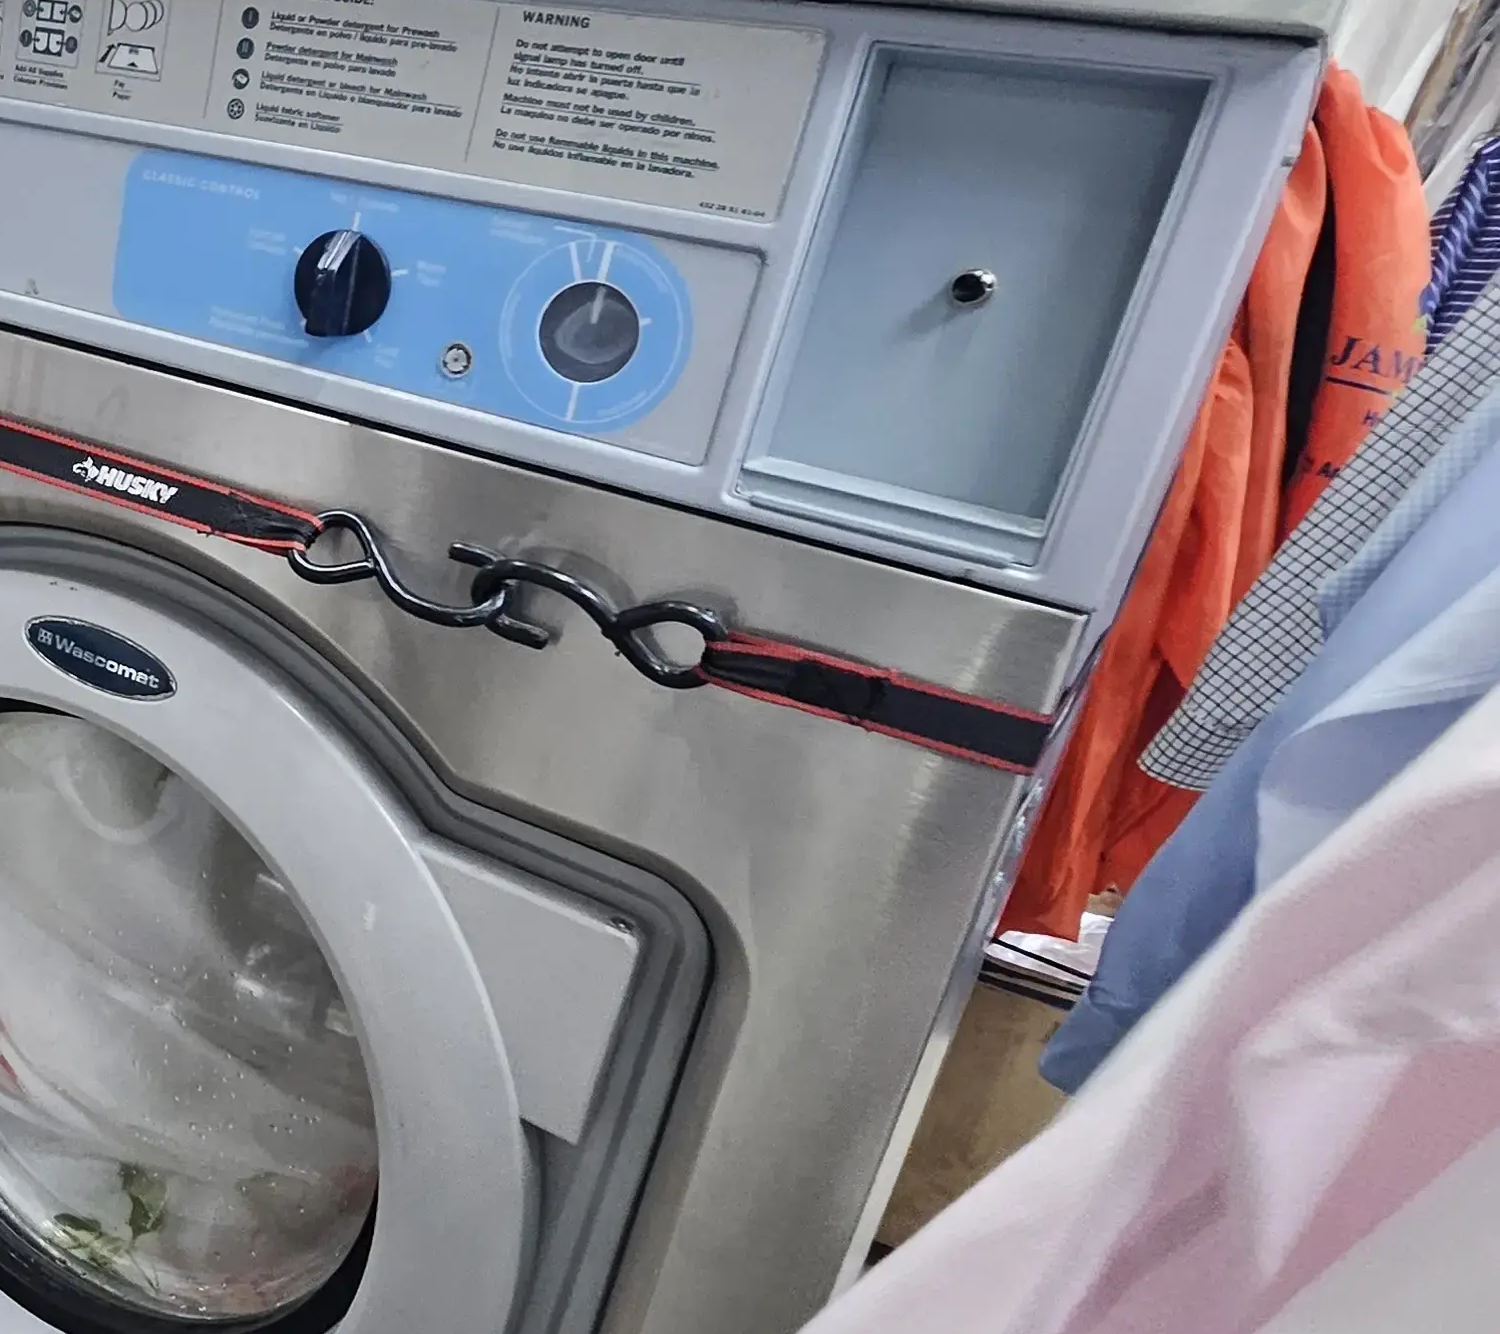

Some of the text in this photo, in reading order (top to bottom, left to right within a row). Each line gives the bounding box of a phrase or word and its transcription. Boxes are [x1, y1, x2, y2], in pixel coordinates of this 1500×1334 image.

[271, 11, 296, 23] Liquid
[297, 15, 307, 23] or
[308, 14, 341, 26] Powder
[342, 19, 384, 33] detergent
[386, 24, 399, 32] for
[523, 10, 591, 28] WARNING
[513, 51, 541, 63] signal
[543, 54, 568, 66] lamp
[569, 58, 587, 68] has
[590, 61, 625, 73] turned
[515, 38, 529, 49] Do
[531, 42, 548, 51] not
[550, 44, 590, 57] attempt
[591, 48, 603, 57] to
[605, 51, 631, 60] open
[633, 52, 658, 63] door
[509, 65, 524, 75] No
[502, 92, 544, 106] Machine
[573, 104, 591, 113] not
[592, 105, 605, 115] be
[607, 109, 633, 118] used
[635, 110, 649, 123] by
[571, 115, 597, 126] debe
[662, 129, 682, 138] por
[492, 139, 506, 149] No
[495, 127, 509, 138] Do
[510, 131, 526, 141] not
[528, 134, 547, 144] use
[650, 151, 670, 162] this
[142, 169, 261, 201] CLASSIC CONTROL
[1330, 335, 1428, 384] JAM
[95, 464, 180, 505] HUSKY
[55, 634, 161, 689] Wascomat
